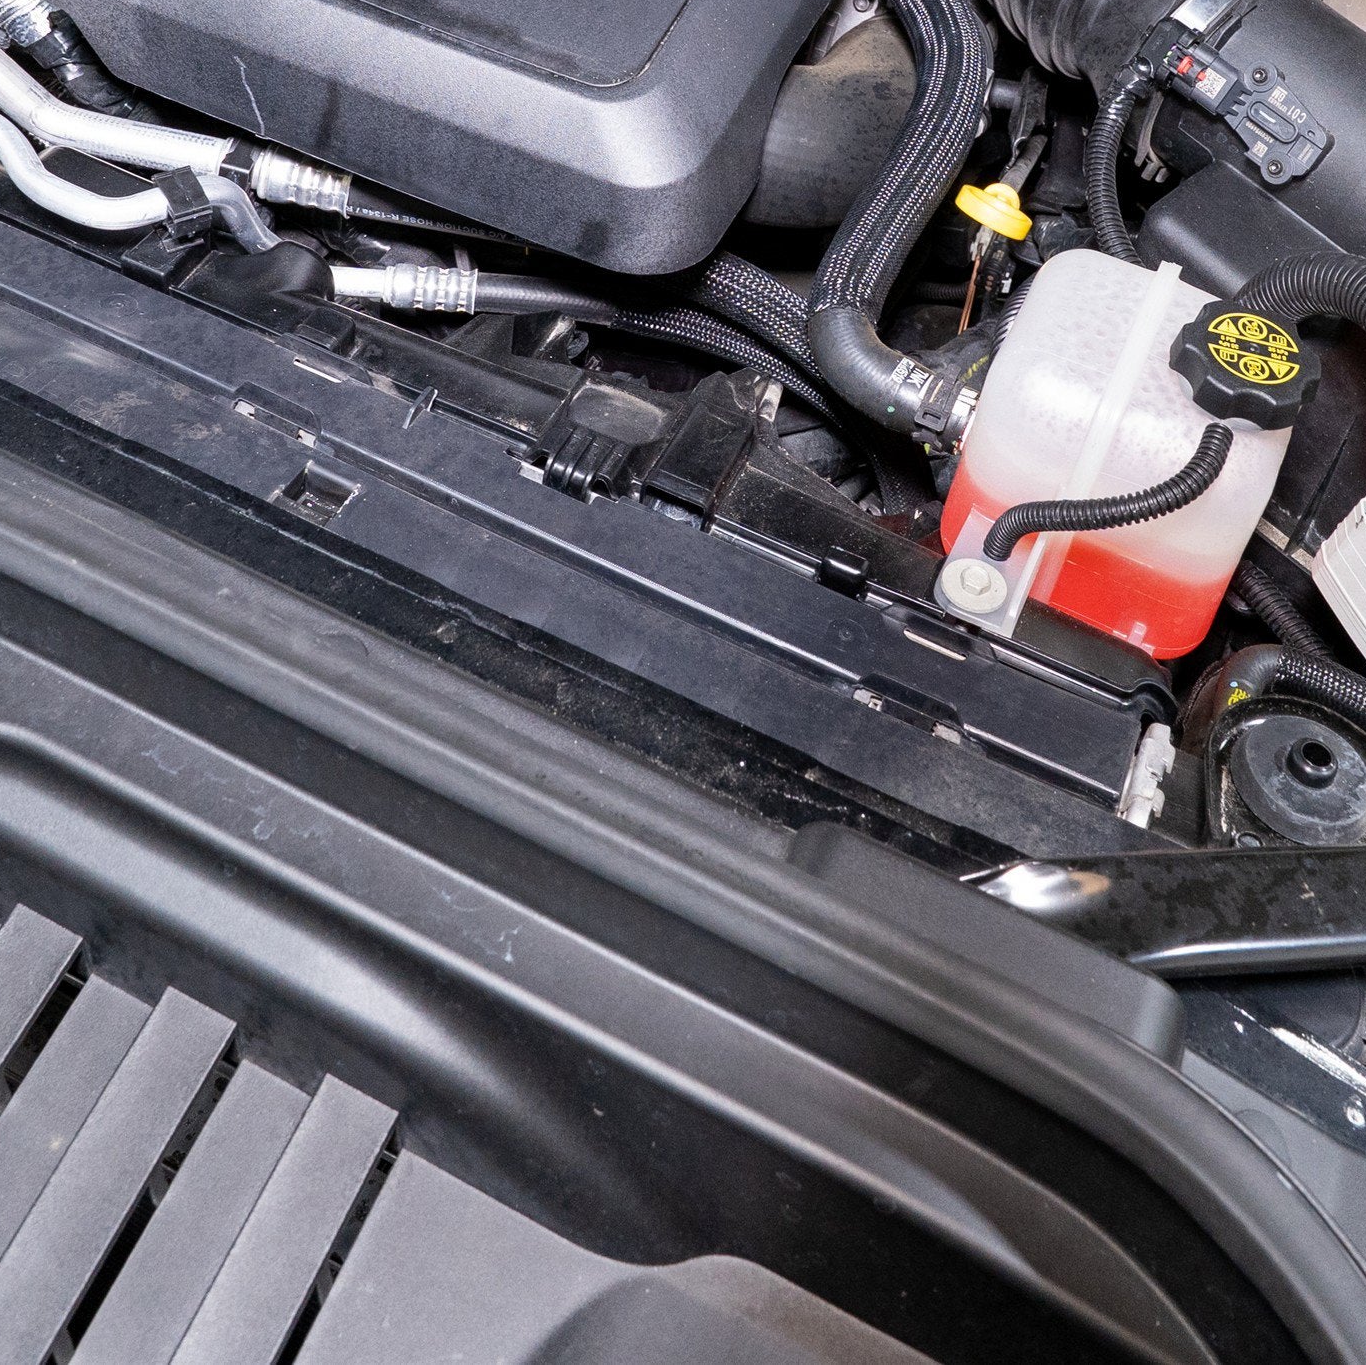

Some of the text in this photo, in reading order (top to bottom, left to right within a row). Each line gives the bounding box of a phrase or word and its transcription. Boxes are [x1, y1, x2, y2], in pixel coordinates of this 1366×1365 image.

[1287, 106, 1307, 124] C01
[362, 207, 401, 221] R-134a
[402, 215, 435, 227] HOSE
[436, 221, 488, 236] SUCTION
[907, 367, 929, 389] TNK
